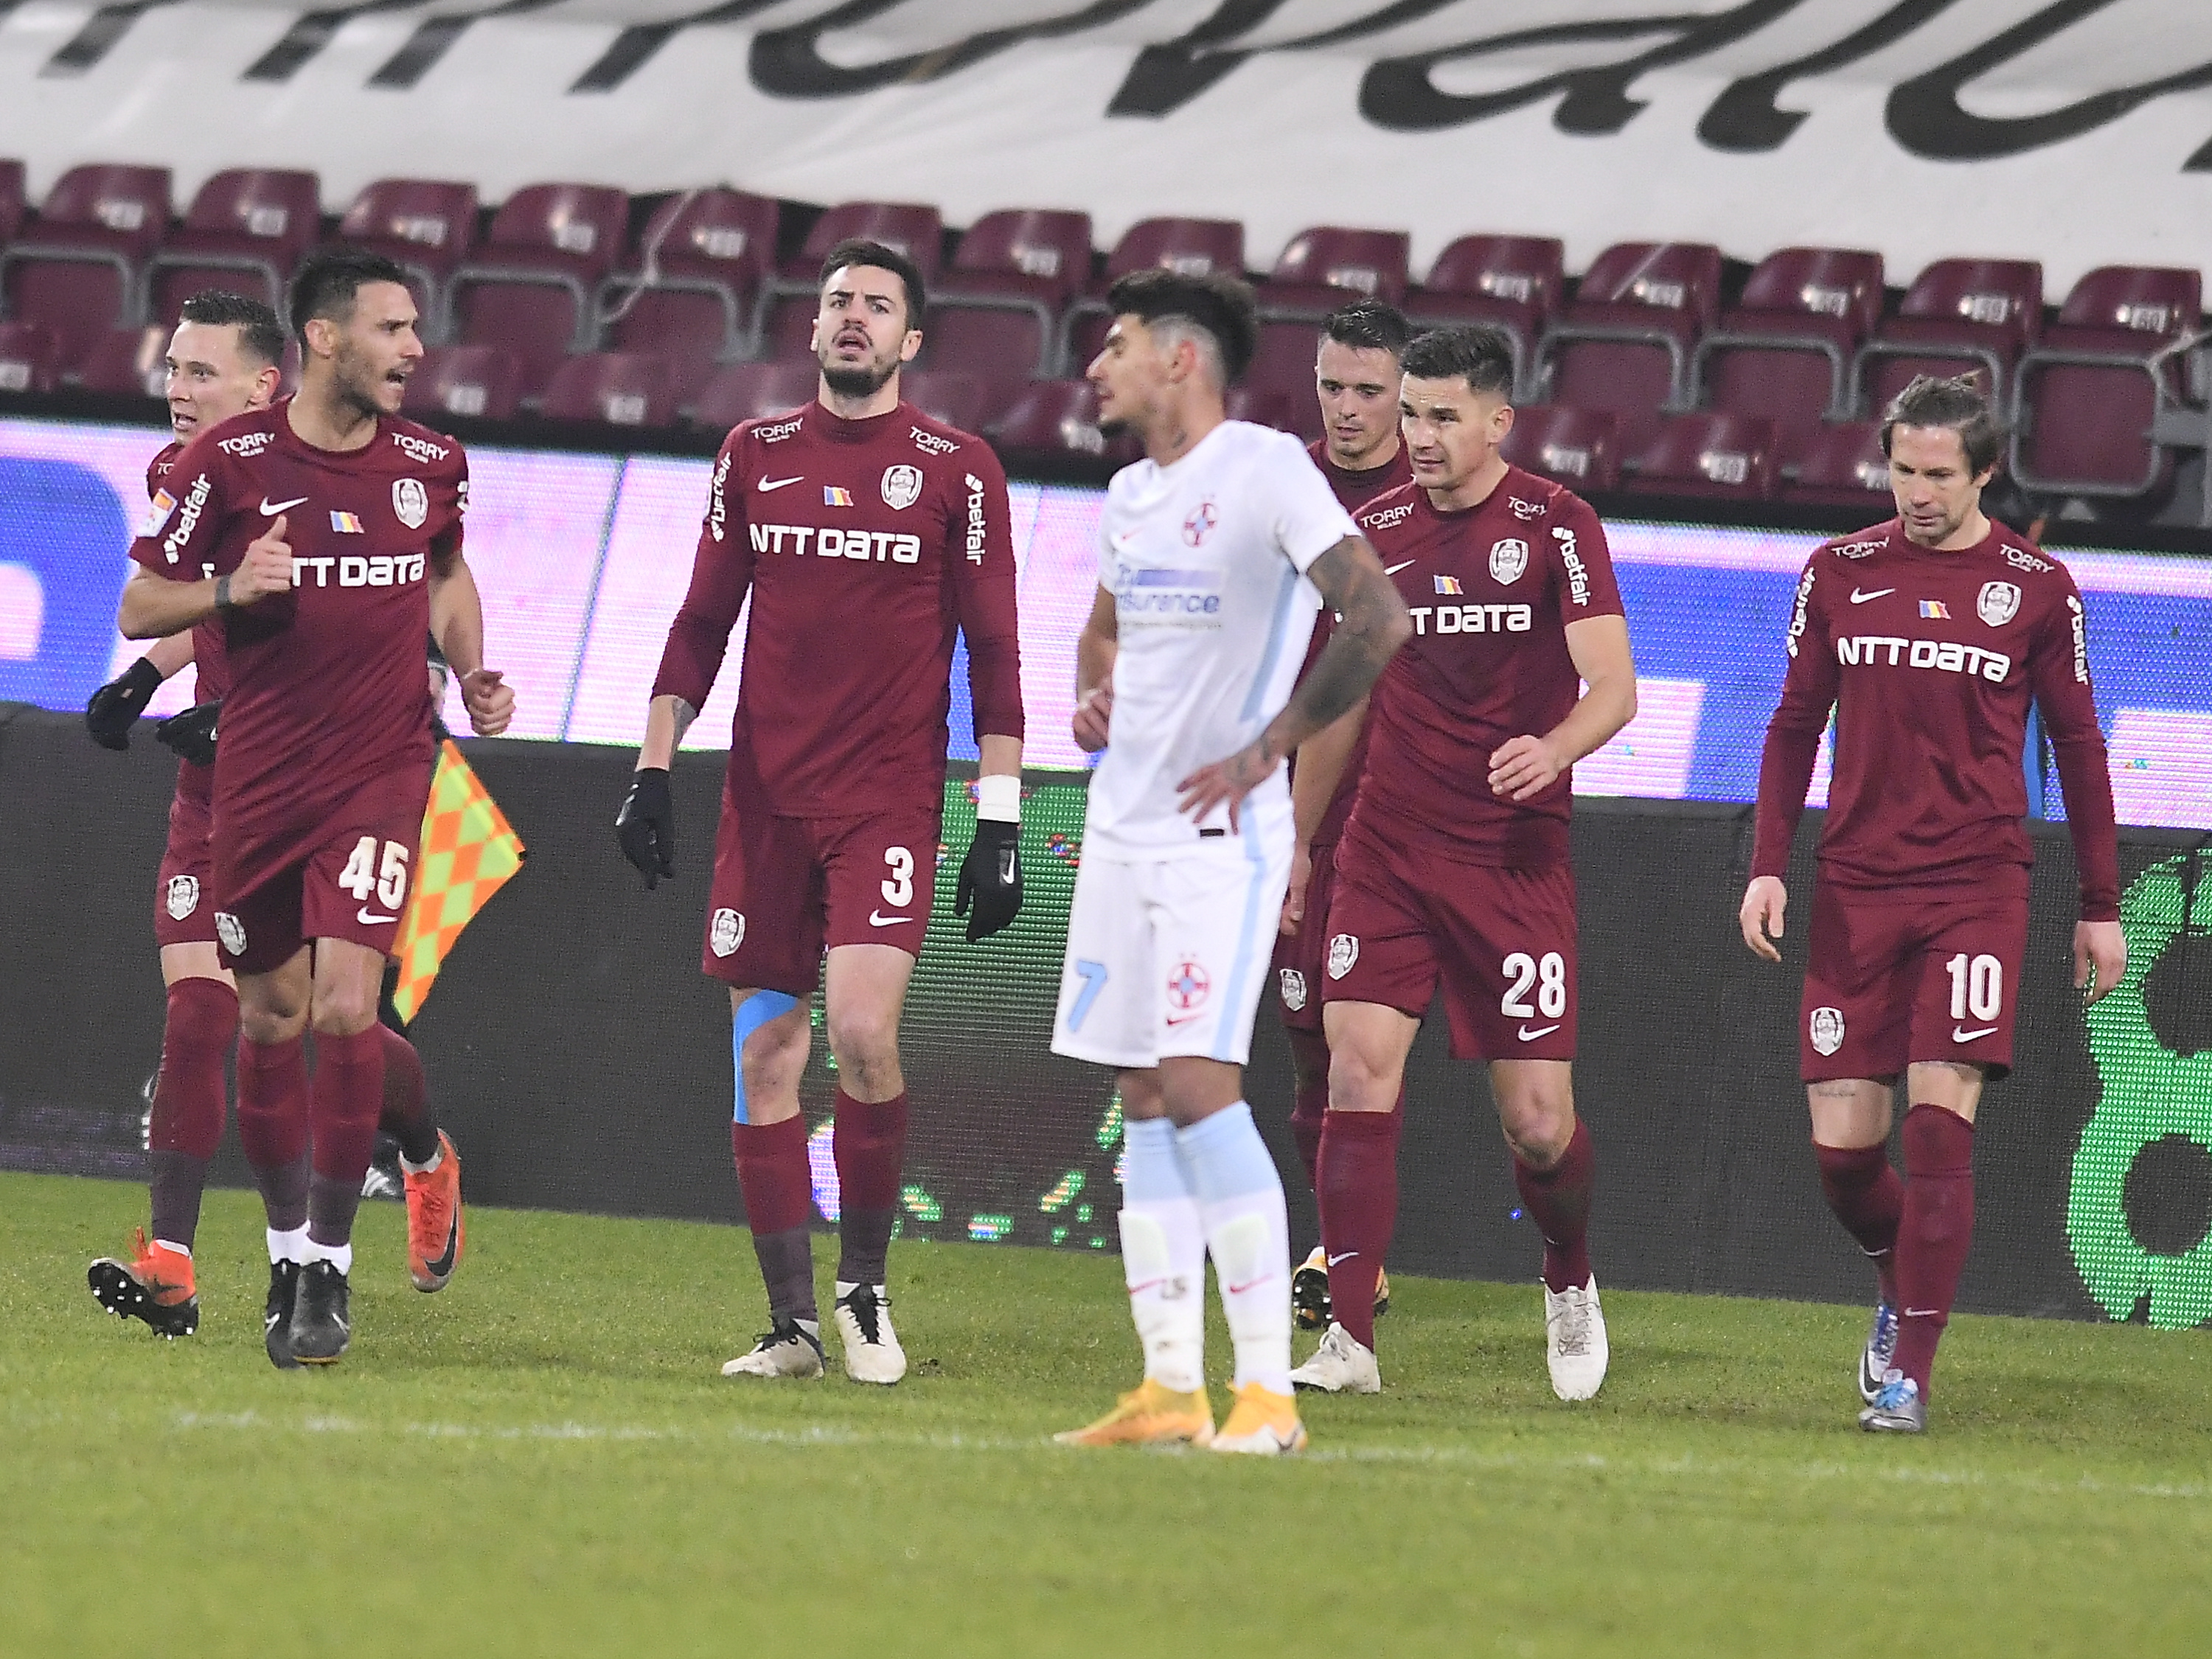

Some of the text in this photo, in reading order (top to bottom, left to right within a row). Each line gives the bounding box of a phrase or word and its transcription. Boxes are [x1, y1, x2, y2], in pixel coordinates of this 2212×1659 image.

[392, 432, 449, 461] TORRY
[751, 417, 804, 439] TORRY
[909, 426, 961, 453] TORRY
[169, 473, 212, 546] betfair
[966, 492, 987, 566] betfair
[1360, 502, 1414, 528] TORRY
[750, 523, 921, 564] NTT DATA
[2000, 543, 2055, 573] TORRY
[292, 553, 425, 588] TT DATA
[1559, 539, 1591, 607] betfair
[1436, 603, 1532, 635] DATA
[1837, 636, 2011, 684] NTT DATA
[339, 836, 409, 910] 45
[881, 846, 915, 908] 3
[1068, 960, 1107, 1033] 7
[1501, 952, 1566, 1018] 28
[1946, 953, 2003, 1021] 10
